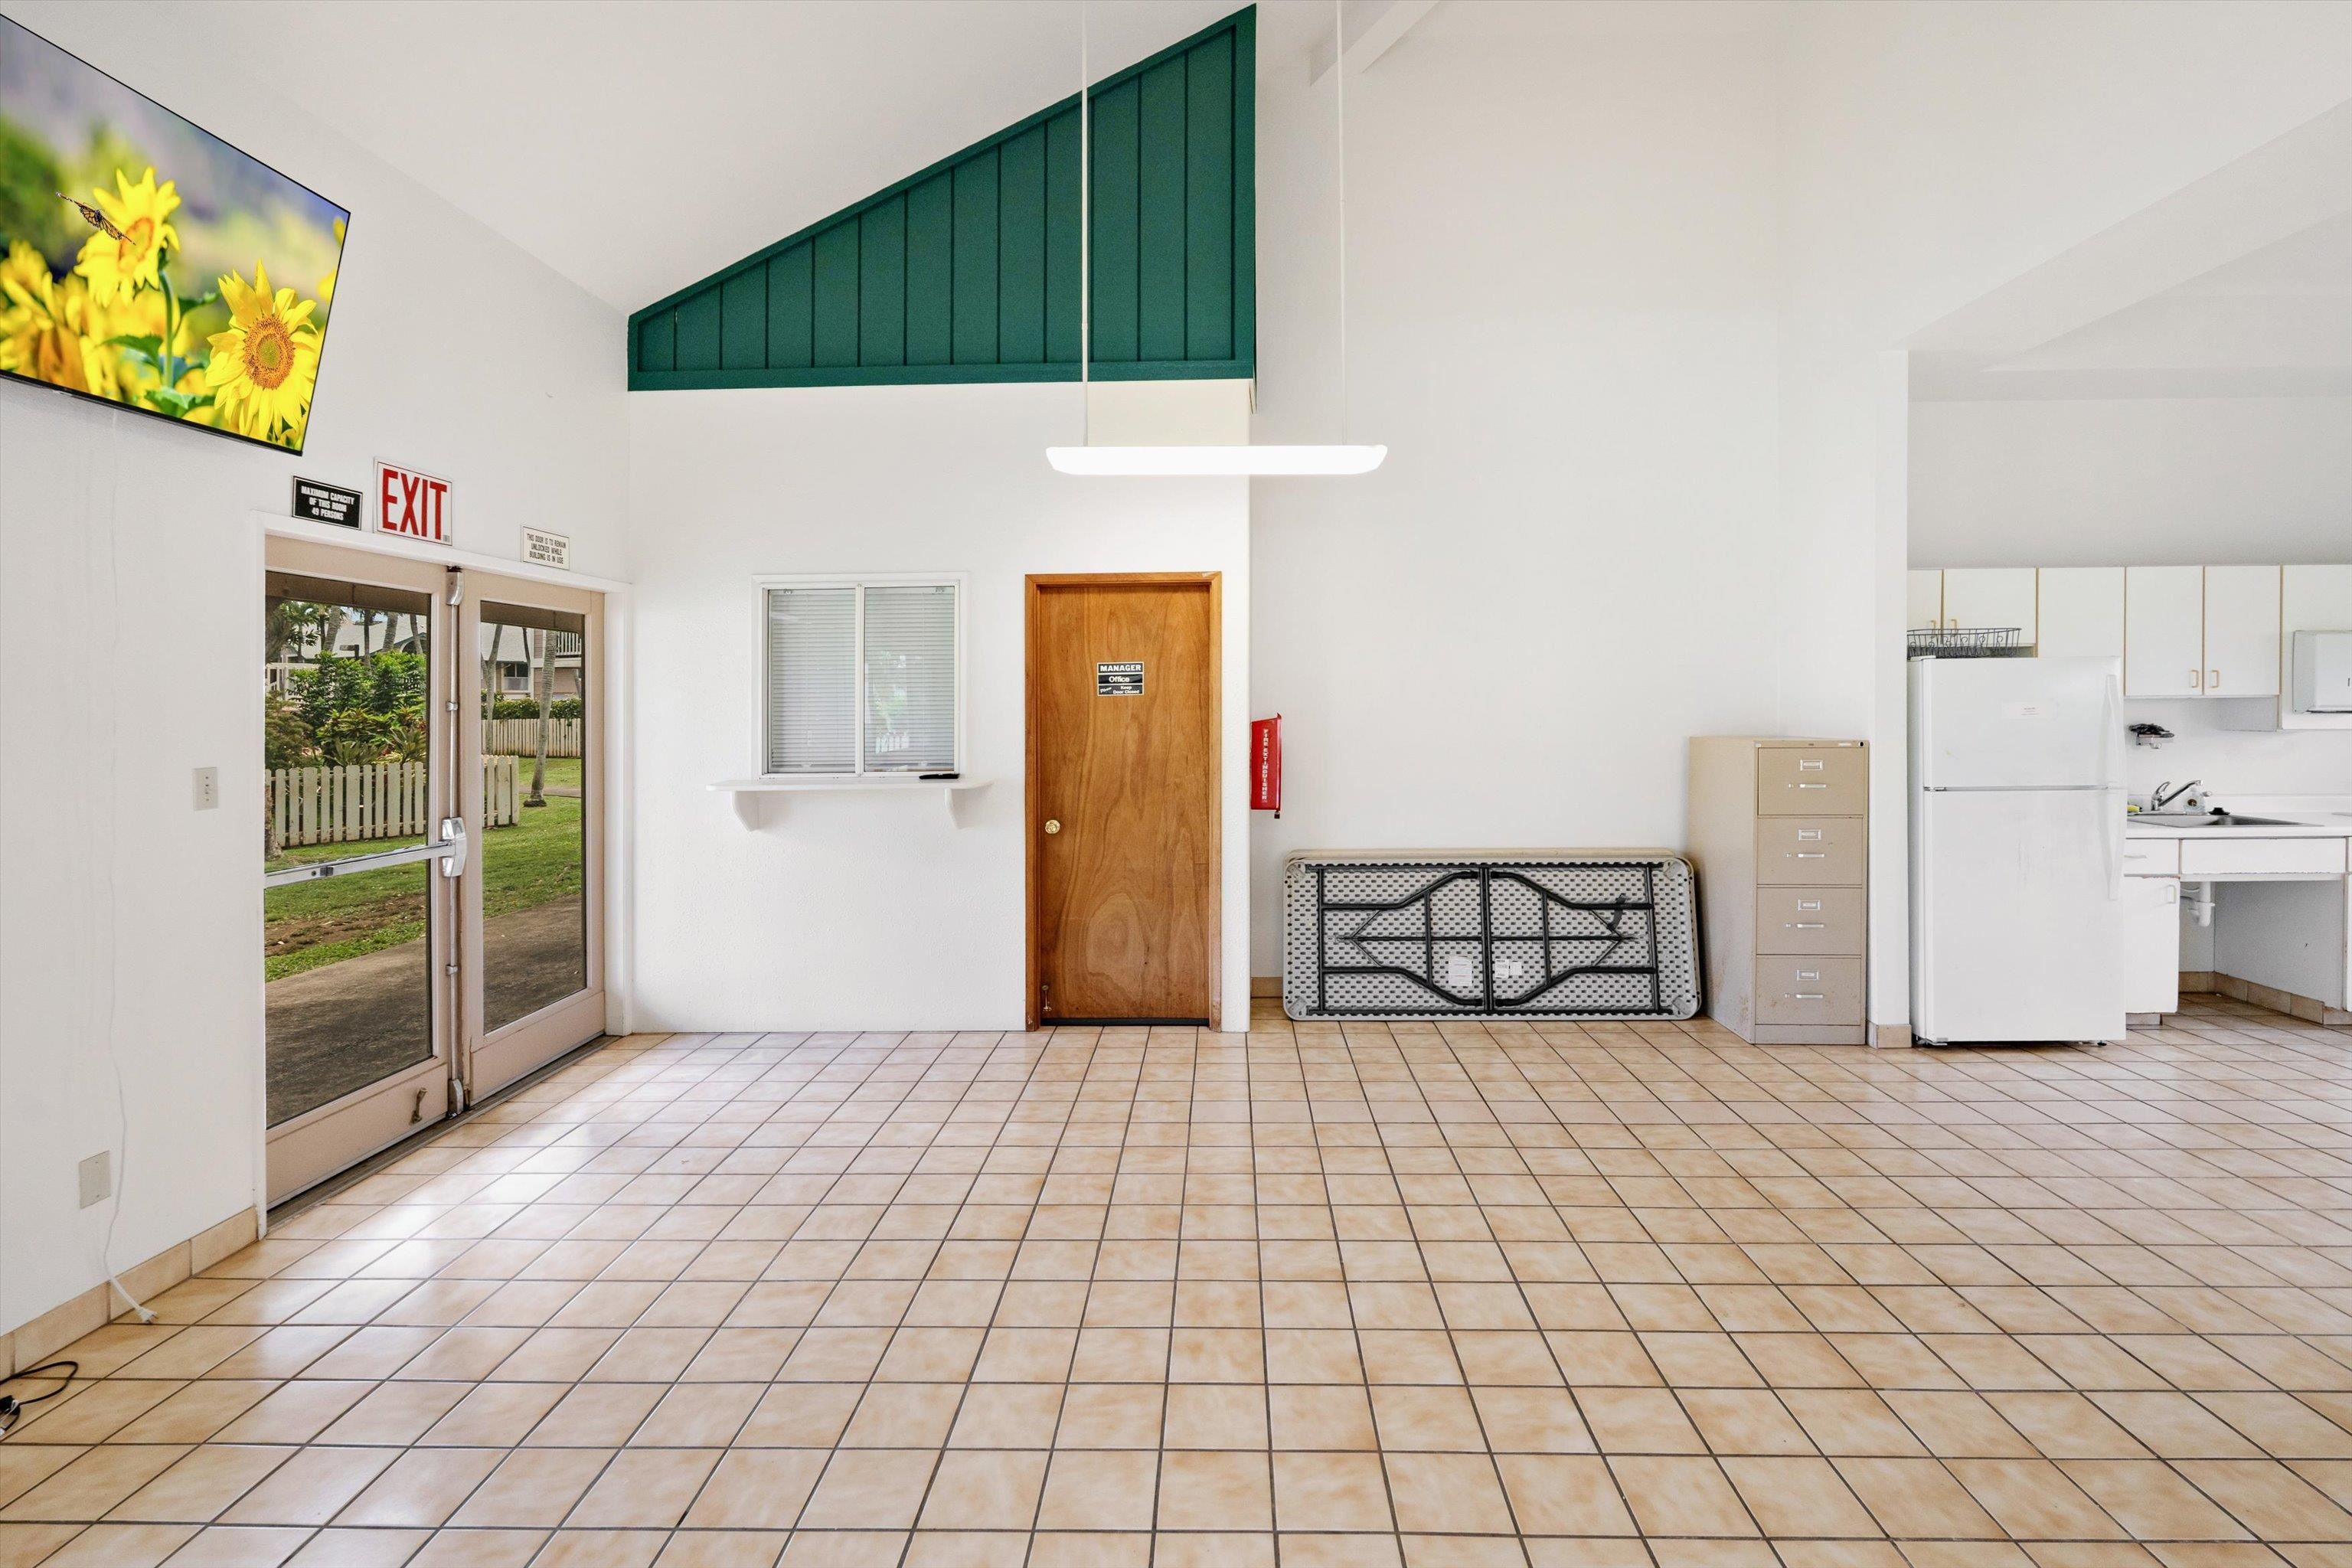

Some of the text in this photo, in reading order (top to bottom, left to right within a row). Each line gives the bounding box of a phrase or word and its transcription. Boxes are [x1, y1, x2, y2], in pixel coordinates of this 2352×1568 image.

[301, 485, 354, 505] MAXIMUM CAPACITY
[309, 497, 347, 512] OF THIS ROOM
[382, 468, 447, 541] EXIT
[312, 507, 344, 521] 49 PERSONS
[535, 535, 544, 544] DOOR
[554, 540, 567, 548] REMAIN
[529, 550, 546, 560] BUILDING
[531, 543, 562, 556] UNLOCKED WHILE
